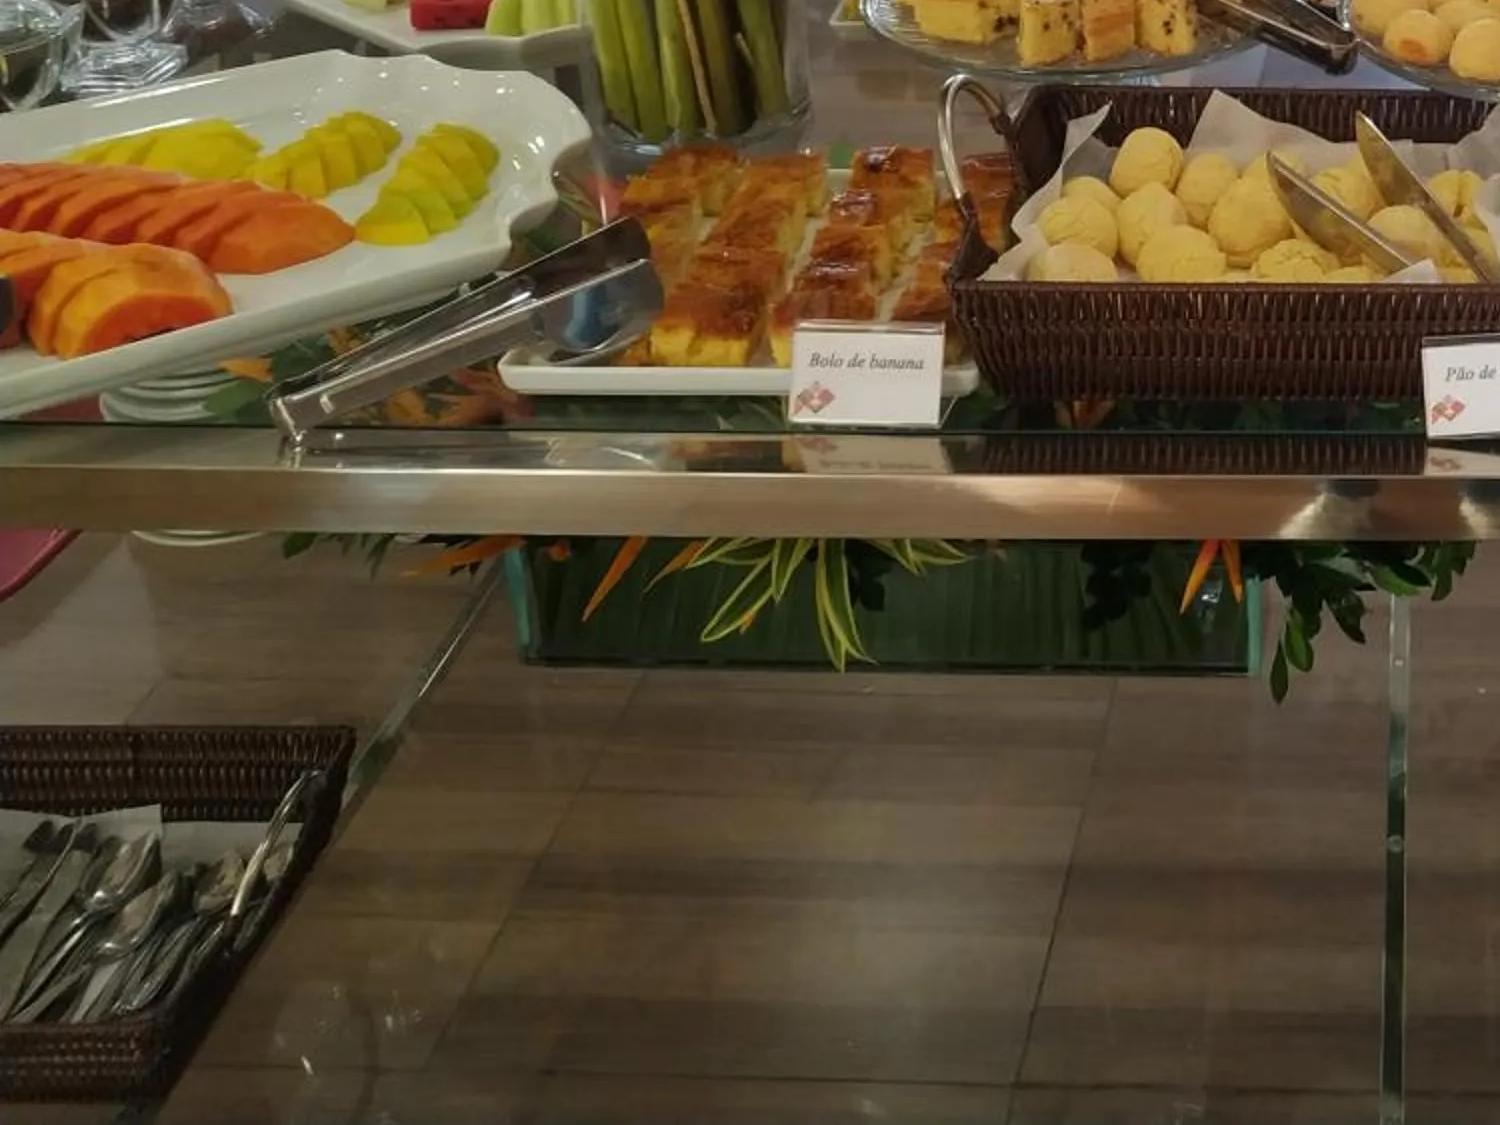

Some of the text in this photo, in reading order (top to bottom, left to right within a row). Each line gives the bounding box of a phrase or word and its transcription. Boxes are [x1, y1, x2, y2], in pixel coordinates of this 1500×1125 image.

[809, 353, 925, 370] Bolo de banana
[1445, 366, 1475, 382] Pão
[1479, 365, 1497, 380] de
